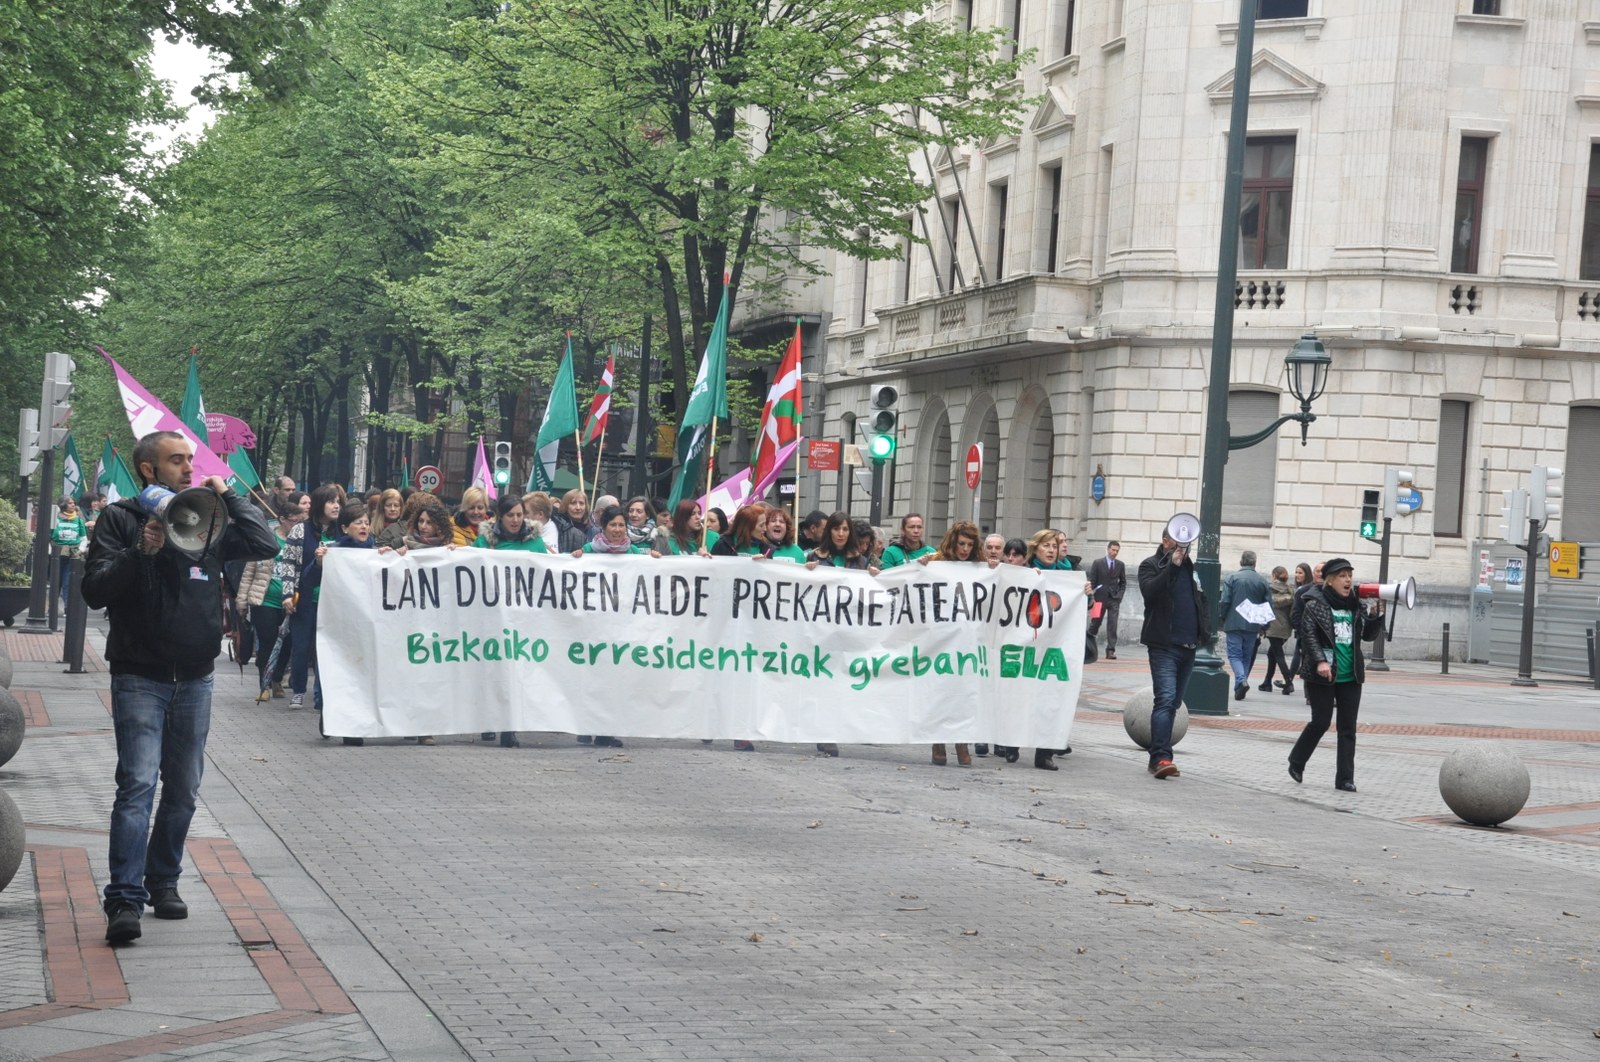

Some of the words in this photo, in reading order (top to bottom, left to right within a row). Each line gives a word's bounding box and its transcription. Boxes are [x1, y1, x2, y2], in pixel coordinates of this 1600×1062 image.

[422, 475, 437, 485] 30
[382, 566, 441, 611] LAN
[455, 565, 620, 613] DUINAREN
[632, 574, 710, 617] ALDE
[732, 577, 996, 627] PREKARIETATEARI
[1000, 585, 1063, 634] STOP
[407, 629, 550, 665] Bizkaiko
[568, 637, 834, 679] erresidentziak
[850, 644, 989, 691] greban!!
[1000, 643, 1070, 682] ELA
